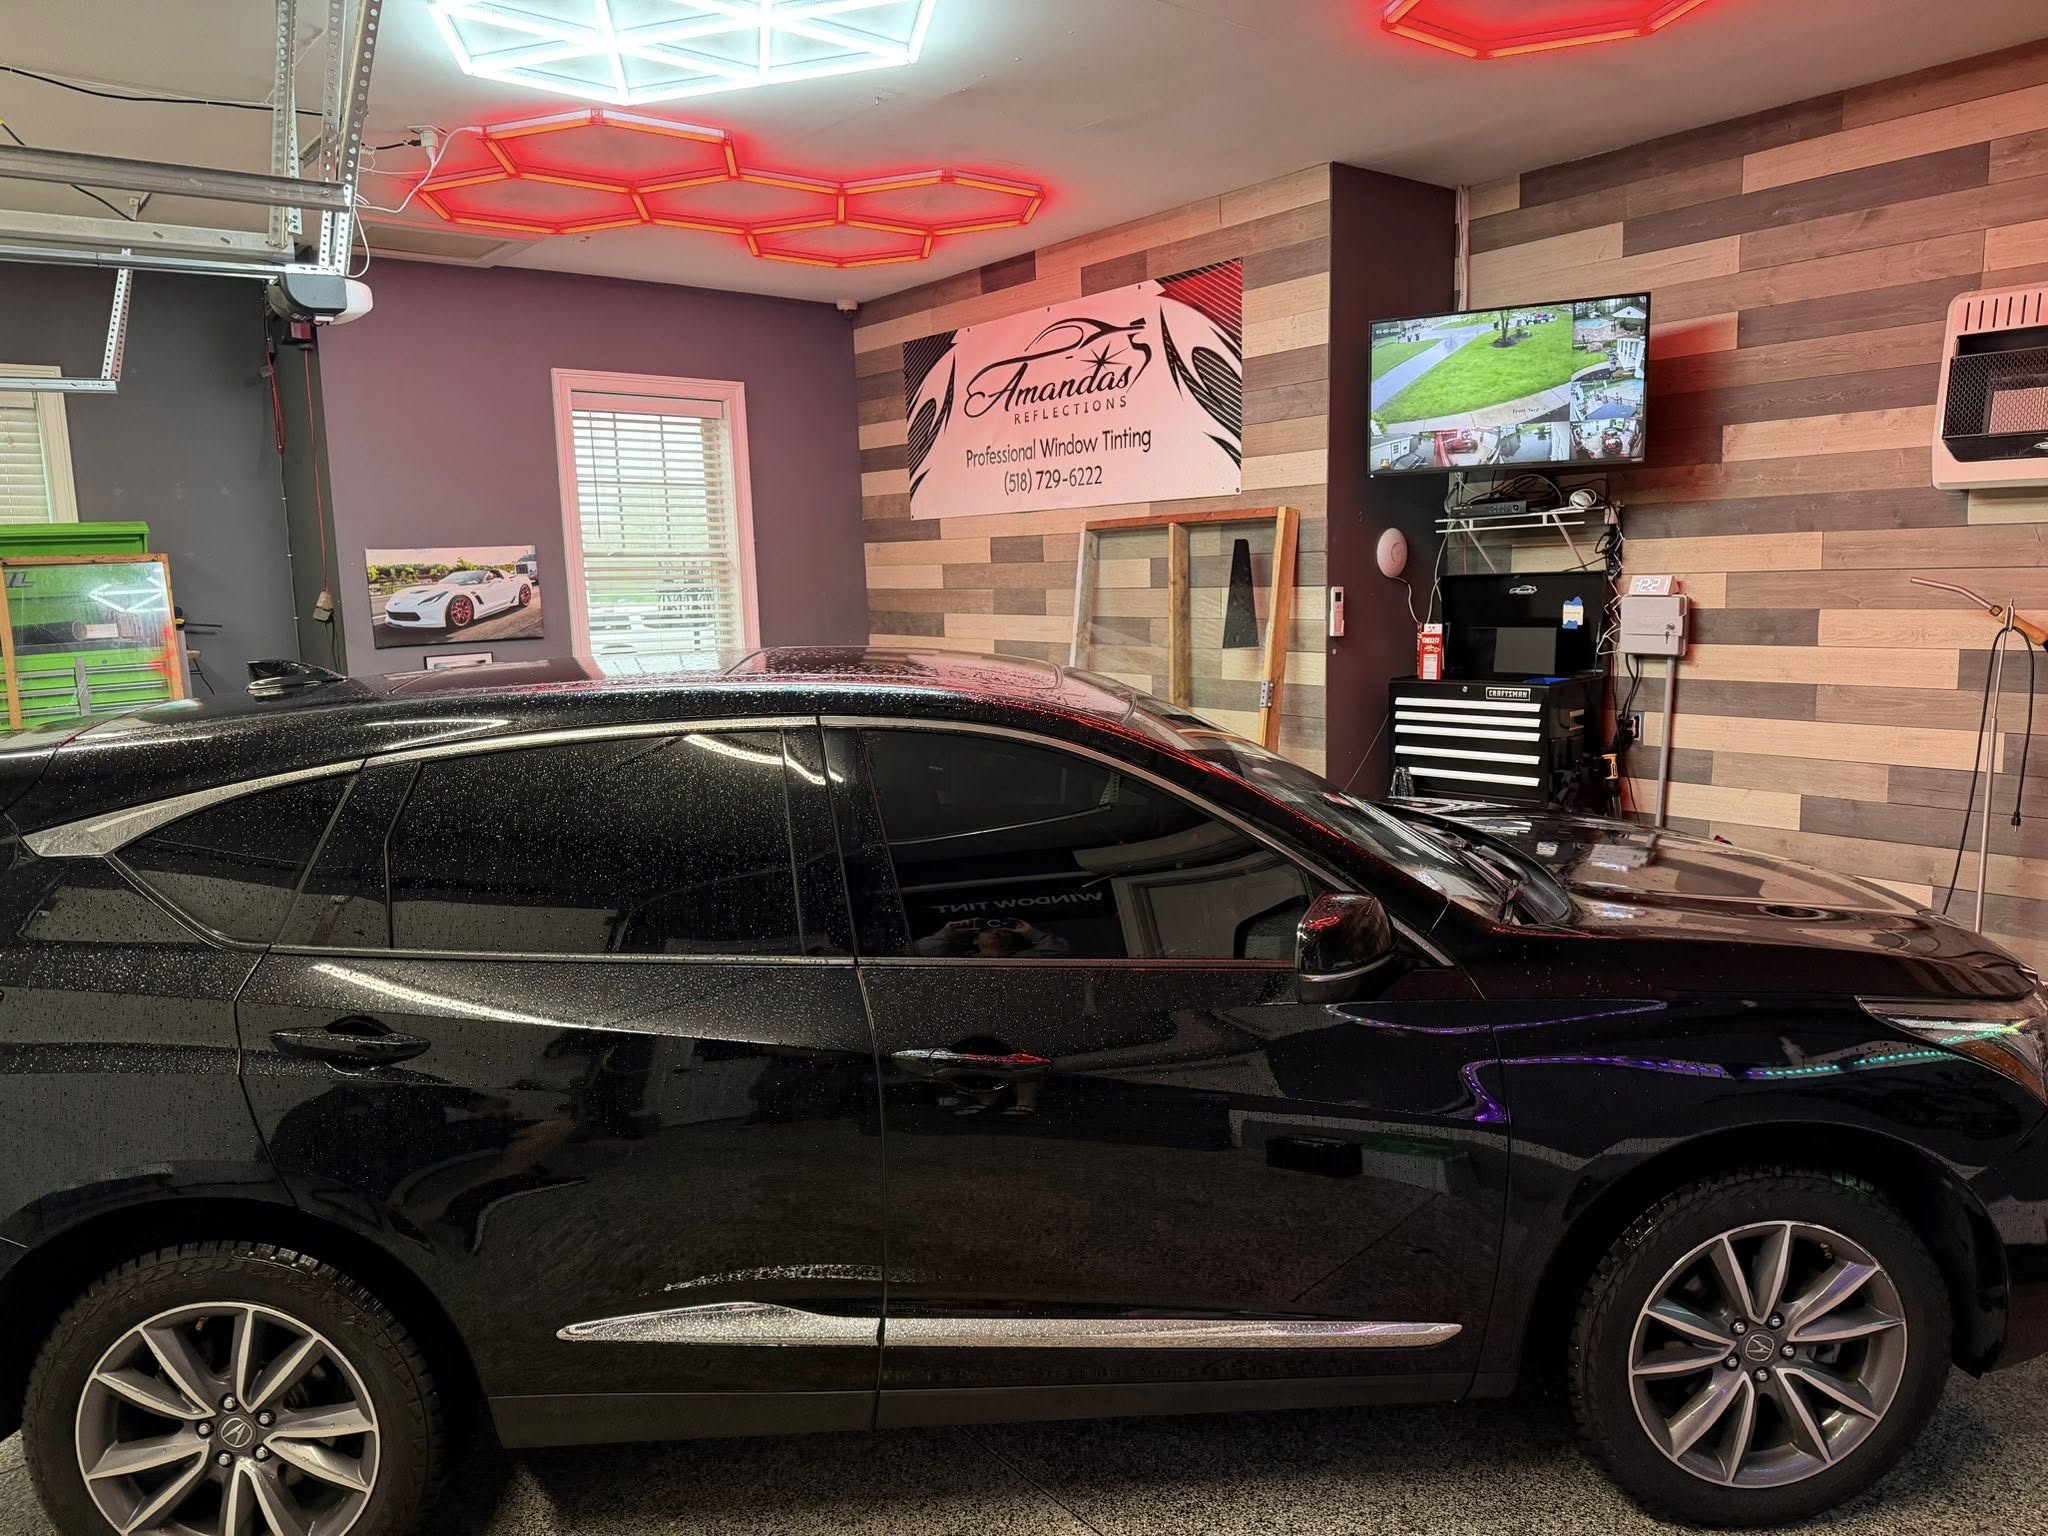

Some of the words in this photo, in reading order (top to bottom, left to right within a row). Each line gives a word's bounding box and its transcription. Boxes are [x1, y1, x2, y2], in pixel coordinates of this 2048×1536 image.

[1014, 395, 1127, 425] REFLECTIONS
[966, 438, 1036, 468] Professional
[1040, 434, 1098, 461] Window
[1102, 426, 1152, 453] Tinting
[1004, 468, 1032, 496] (518)
[1036, 465, 1103, 491] 729-6222
[1488, 690, 1528, 698] CRAFTSMAN
